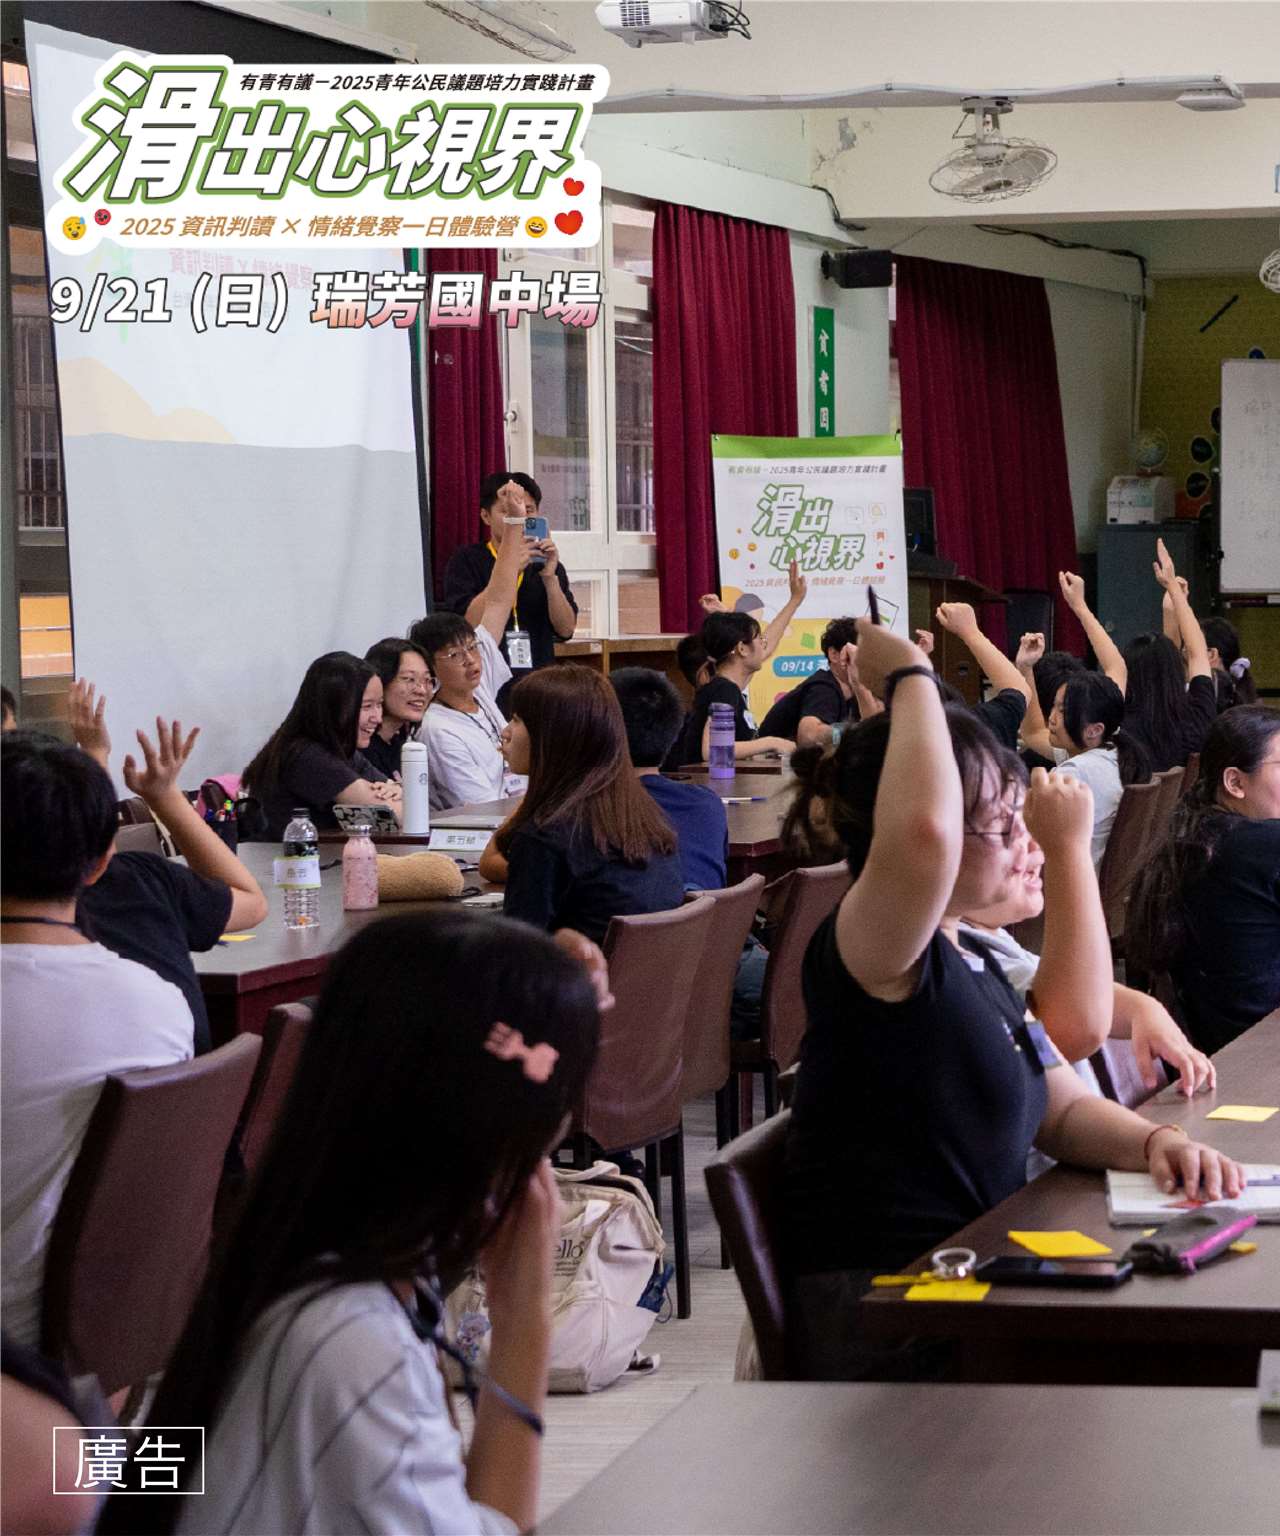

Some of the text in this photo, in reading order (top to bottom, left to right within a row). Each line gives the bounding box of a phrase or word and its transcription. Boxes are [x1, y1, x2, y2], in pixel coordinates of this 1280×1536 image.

[752, 483, 833, 536] 滑出
[769, 531, 865, 571] 心視界
[781, 658, 814, 675] 09/14
[553, 1239, 584, 1260] ello
